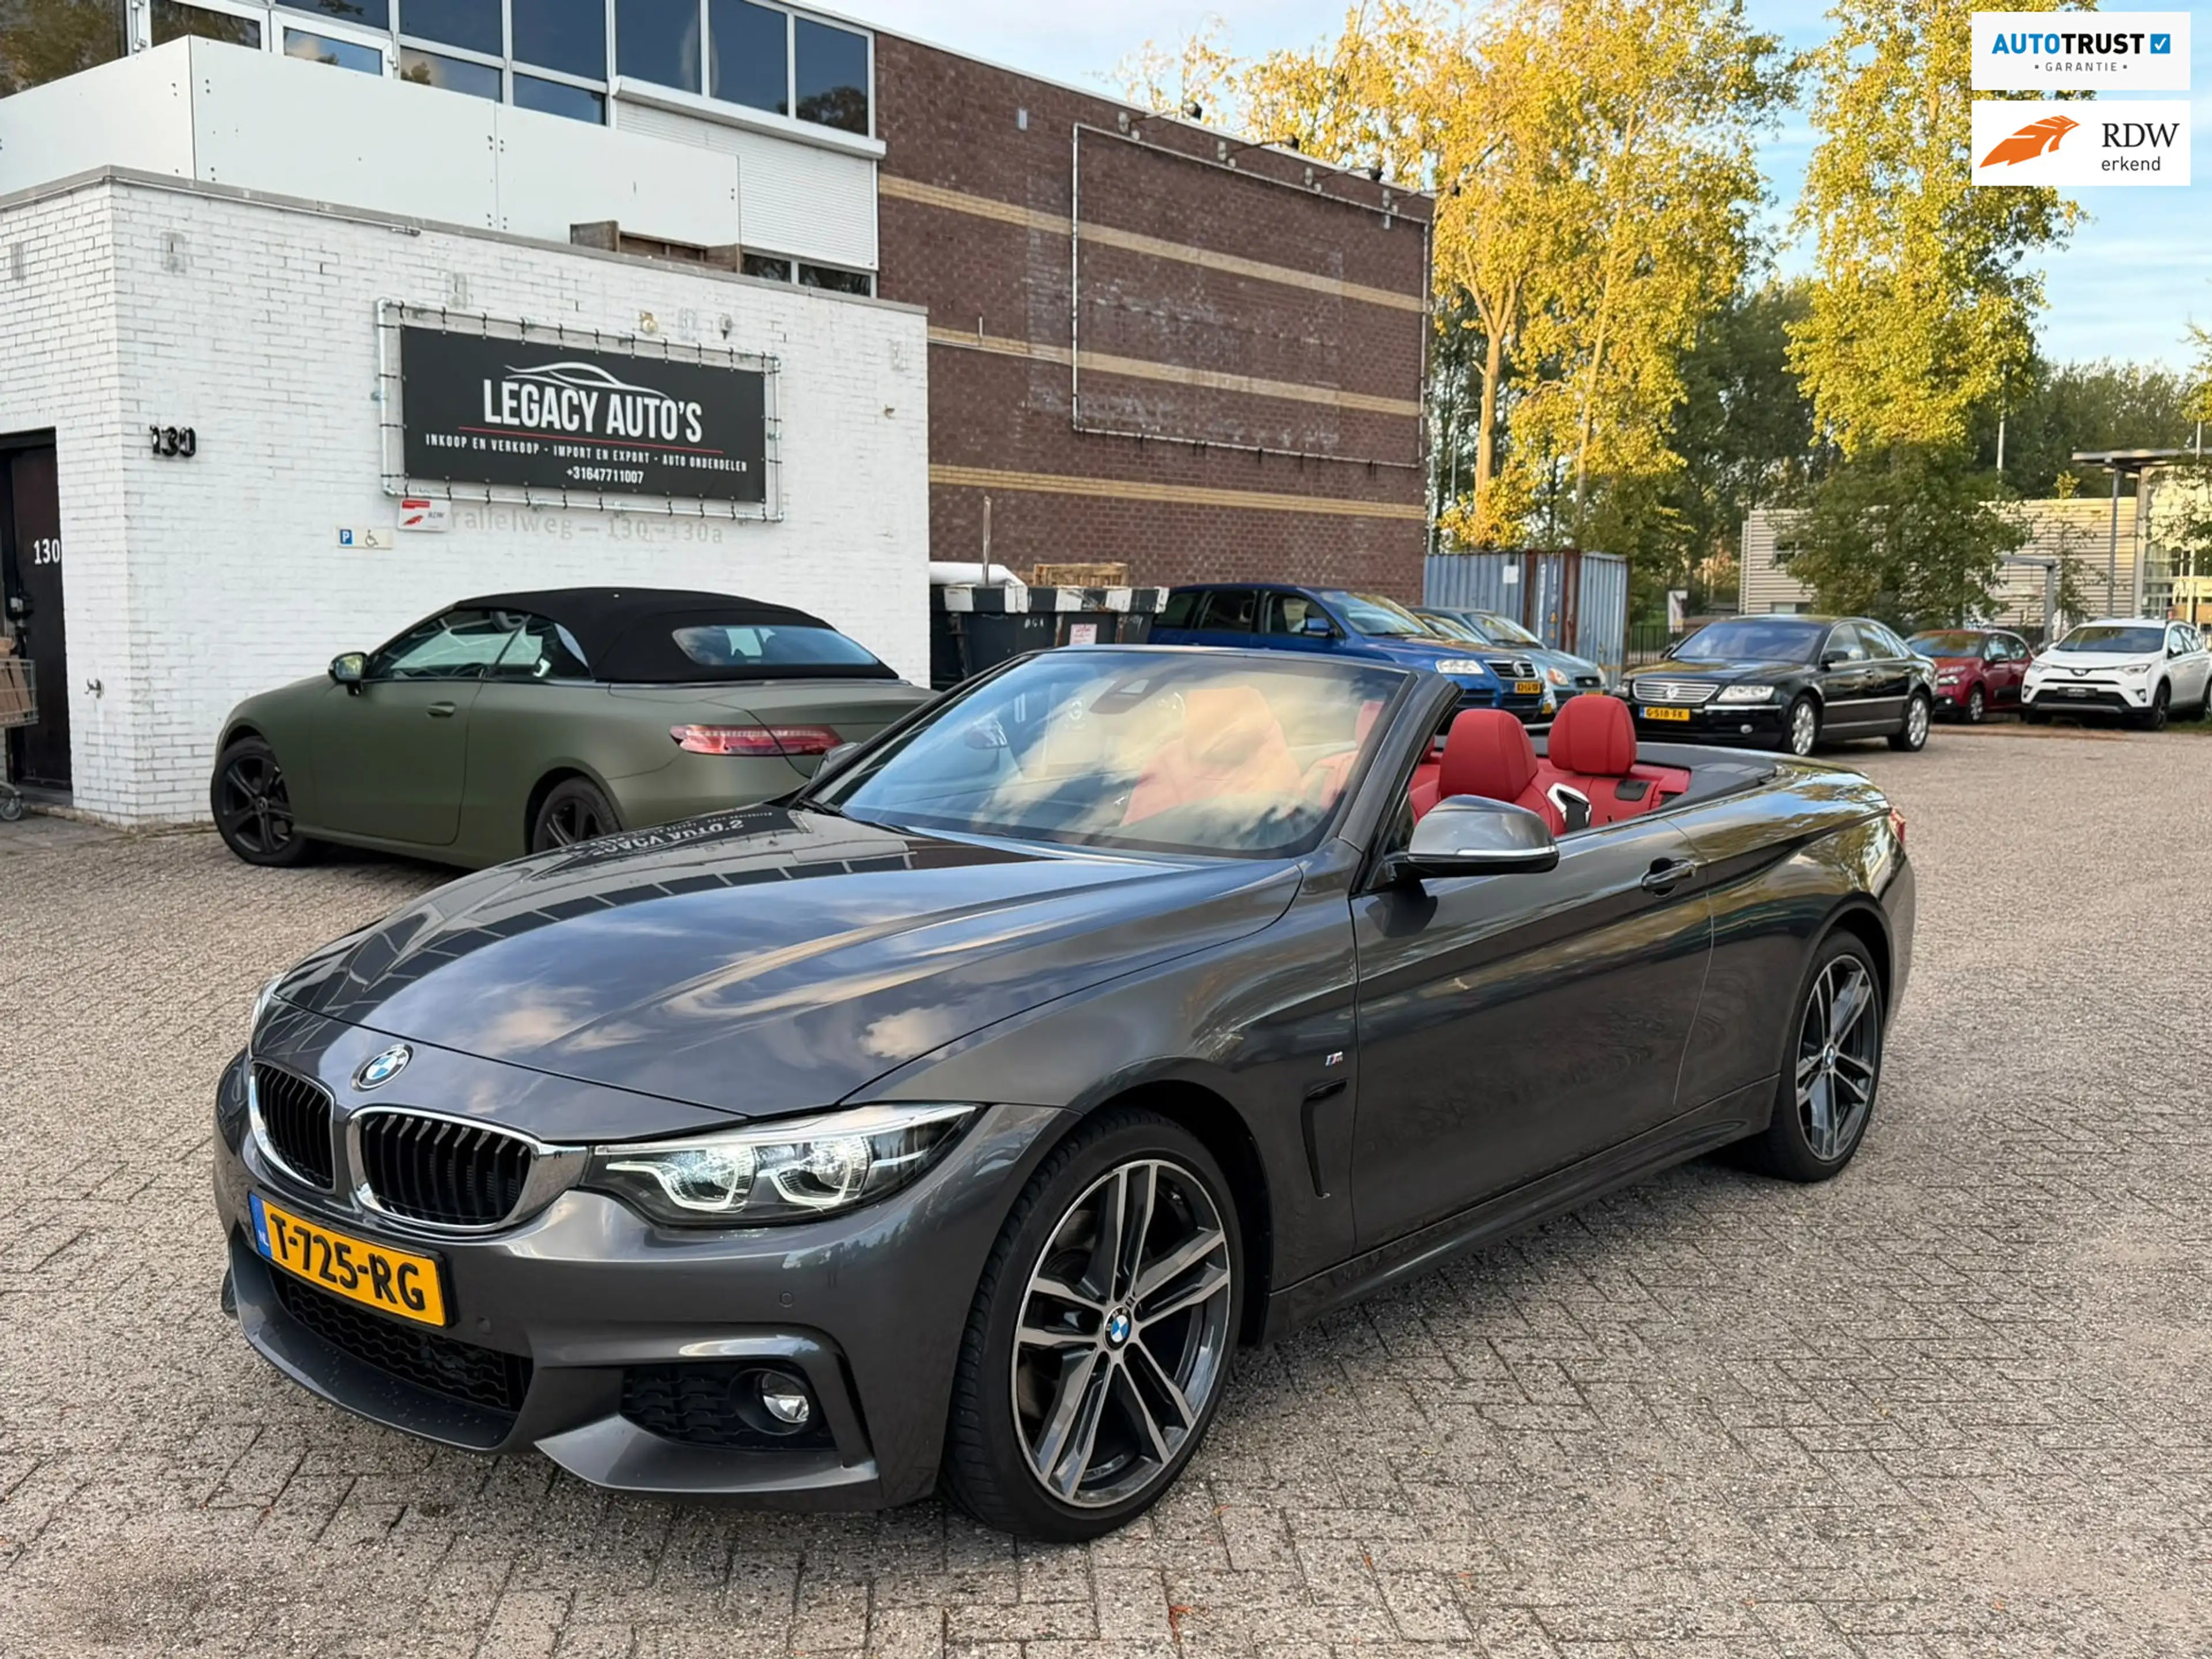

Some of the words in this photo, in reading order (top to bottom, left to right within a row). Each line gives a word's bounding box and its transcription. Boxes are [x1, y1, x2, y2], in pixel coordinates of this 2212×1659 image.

[483, 378, 599, 433] LEGACY
[605, 393, 703, 443] AUTO'S
[150, 424, 197, 457] 130
[426, 433, 468, 448] INKOOP
[472, 437, 486, 450] EN
[491, 439, 540, 455] VERKOOP
[553, 445, 592, 459] IMPORT
[596, 448, 608, 461] EN
[613, 449, 650, 464] EXPORT
[662, 454, 686, 467] AUTO
[566, 465, 644, 484] +31647711007
[451, 507, 574, 540] rallelweg
[33, 537, 62, 565] 130
[270, 1213, 426, 1311] T-725-RG
